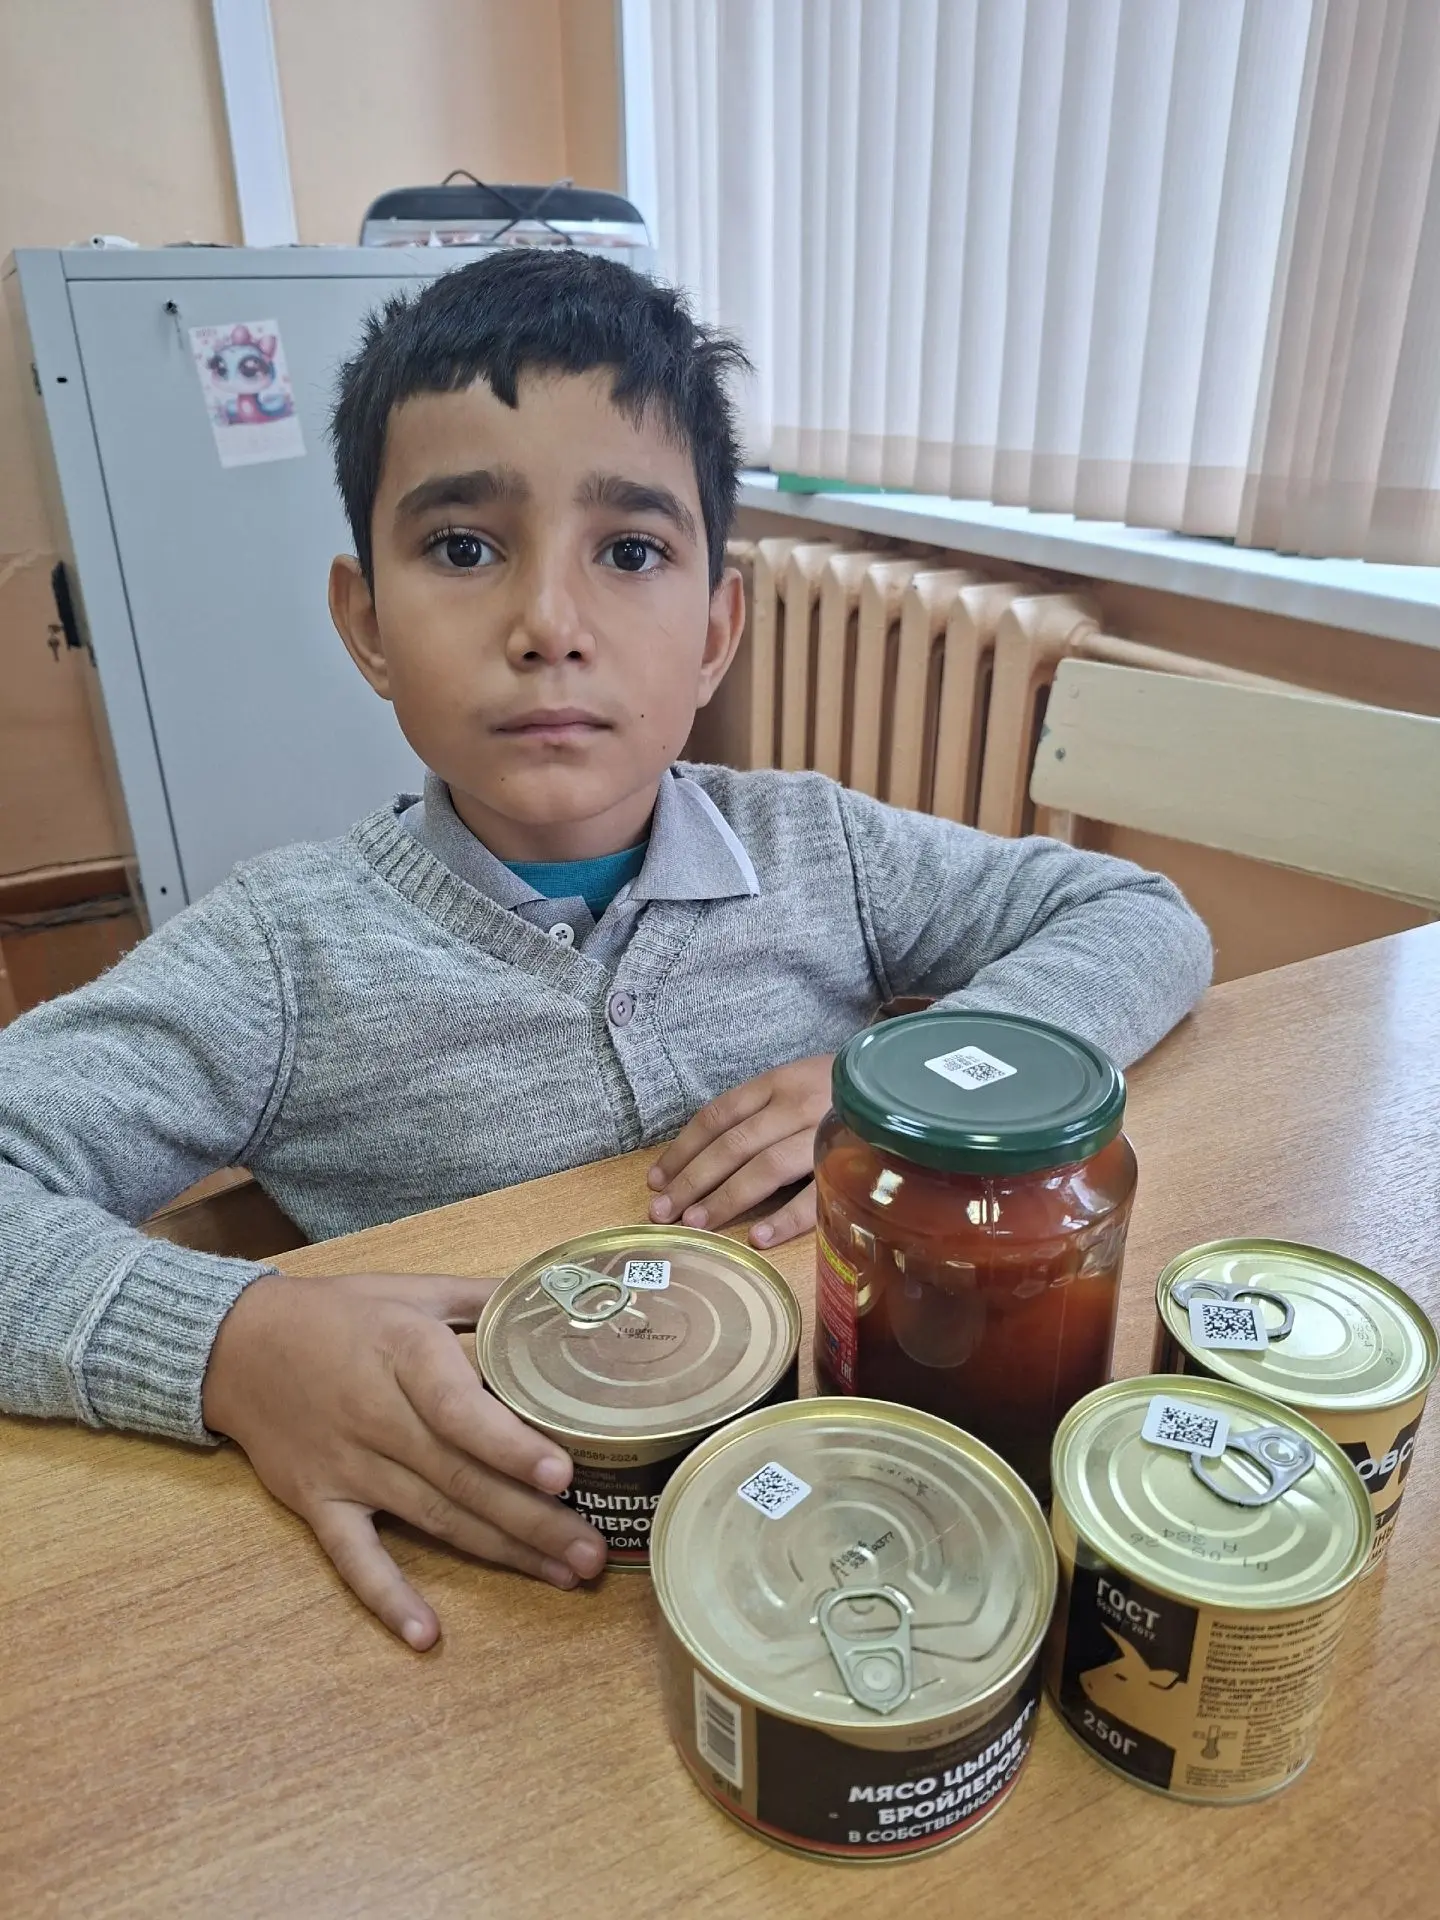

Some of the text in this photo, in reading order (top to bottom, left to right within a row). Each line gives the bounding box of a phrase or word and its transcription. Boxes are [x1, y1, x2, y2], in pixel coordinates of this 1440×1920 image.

[1355, 1436, 1414, 1480] ОВС
[575, 1490, 661, 1510] ЦЫПЛЯ
[1097, 1577, 1161, 1630] ГОСТ
[848, 1778, 937, 1802] МЯСО
[878, 1738, 1022, 1825] БРОЙЛЕРОВ
[848, 1831, 861, 1843] В
[866, 1779, 1003, 1843] СОБСТВЕННОМ
